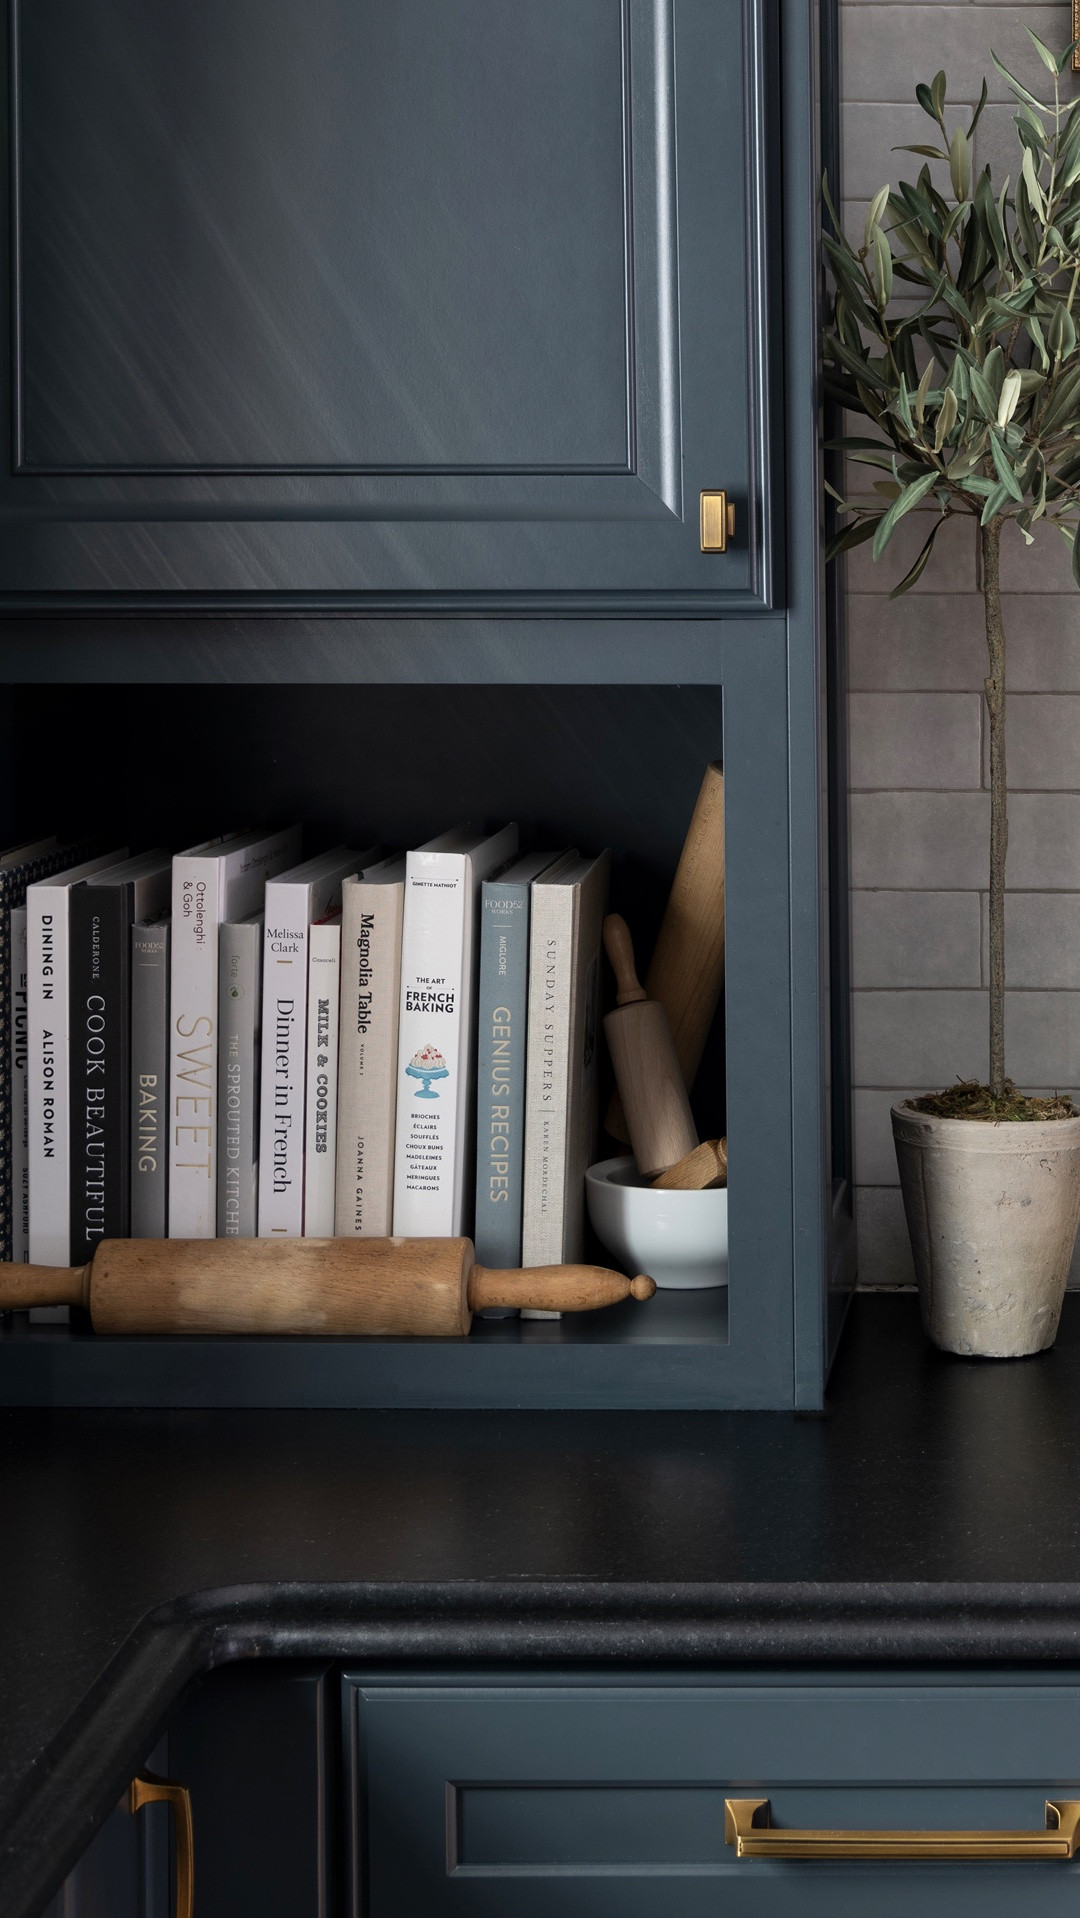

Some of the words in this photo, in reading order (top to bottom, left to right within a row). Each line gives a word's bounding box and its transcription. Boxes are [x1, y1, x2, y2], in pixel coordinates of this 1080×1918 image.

[182, 881, 193, 890] &
[182, 893, 193, 917] Goh
[485, 899, 524, 909] FOOD52
[193, 881, 206, 944] Ottolenghi
[267, 928, 304, 940] Melissa
[42, 916, 53, 976] DINING
[92, 916, 100, 978] CALDERONE
[229, 955, 240, 978] forte
[271, 942, 299, 953] Clark
[357, 913, 375, 987] Magnolia
[498, 935, 507, 976] MIGLORE
[43, 983, 53, 999] IN
[406, 991, 455, 1003] FRENCH
[545, 939, 556, 1012] SUNDAY
[317, 999, 330, 1047] MILK
[357, 991, 373, 1034] Table
[406, 1002, 454, 1014] BAKING
[43, 1029, 54, 1090] ALISON
[86, 995, 105, 1075] COOK
[228, 1034, 239, 1057] THE
[275, 998, 295, 1084] Dinner
[317, 1054, 328, 1067] &
[492, 1006, 511, 1096] GENIUS
[542, 1024, 554, 1101] SUPPERS
[175, 1014, 213, 1178] SWEET
[226, 1063, 240, 1159] SPROUTED
[275, 1086, 293, 1107] in
[316, 1074, 328, 1153] COOKIES
[43, 1098, 54, 1157] ROMAN
[138, 1074, 157, 1172] BAKING
[413, 1122, 437, 1130] ÉCLAIRS
[86, 1088, 105, 1240] BEAUTIFUL
[273, 1114, 292, 1193] French
[356, 1136, 364, 1181] JOANNA
[410, 1163, 437, 1171] GÂTEAUX
[489, 1105, 510, 1202] RECIPES
[226, 1167, 239, 1236] KITCHE
[354, 1187, 363, 1231] GAINES
